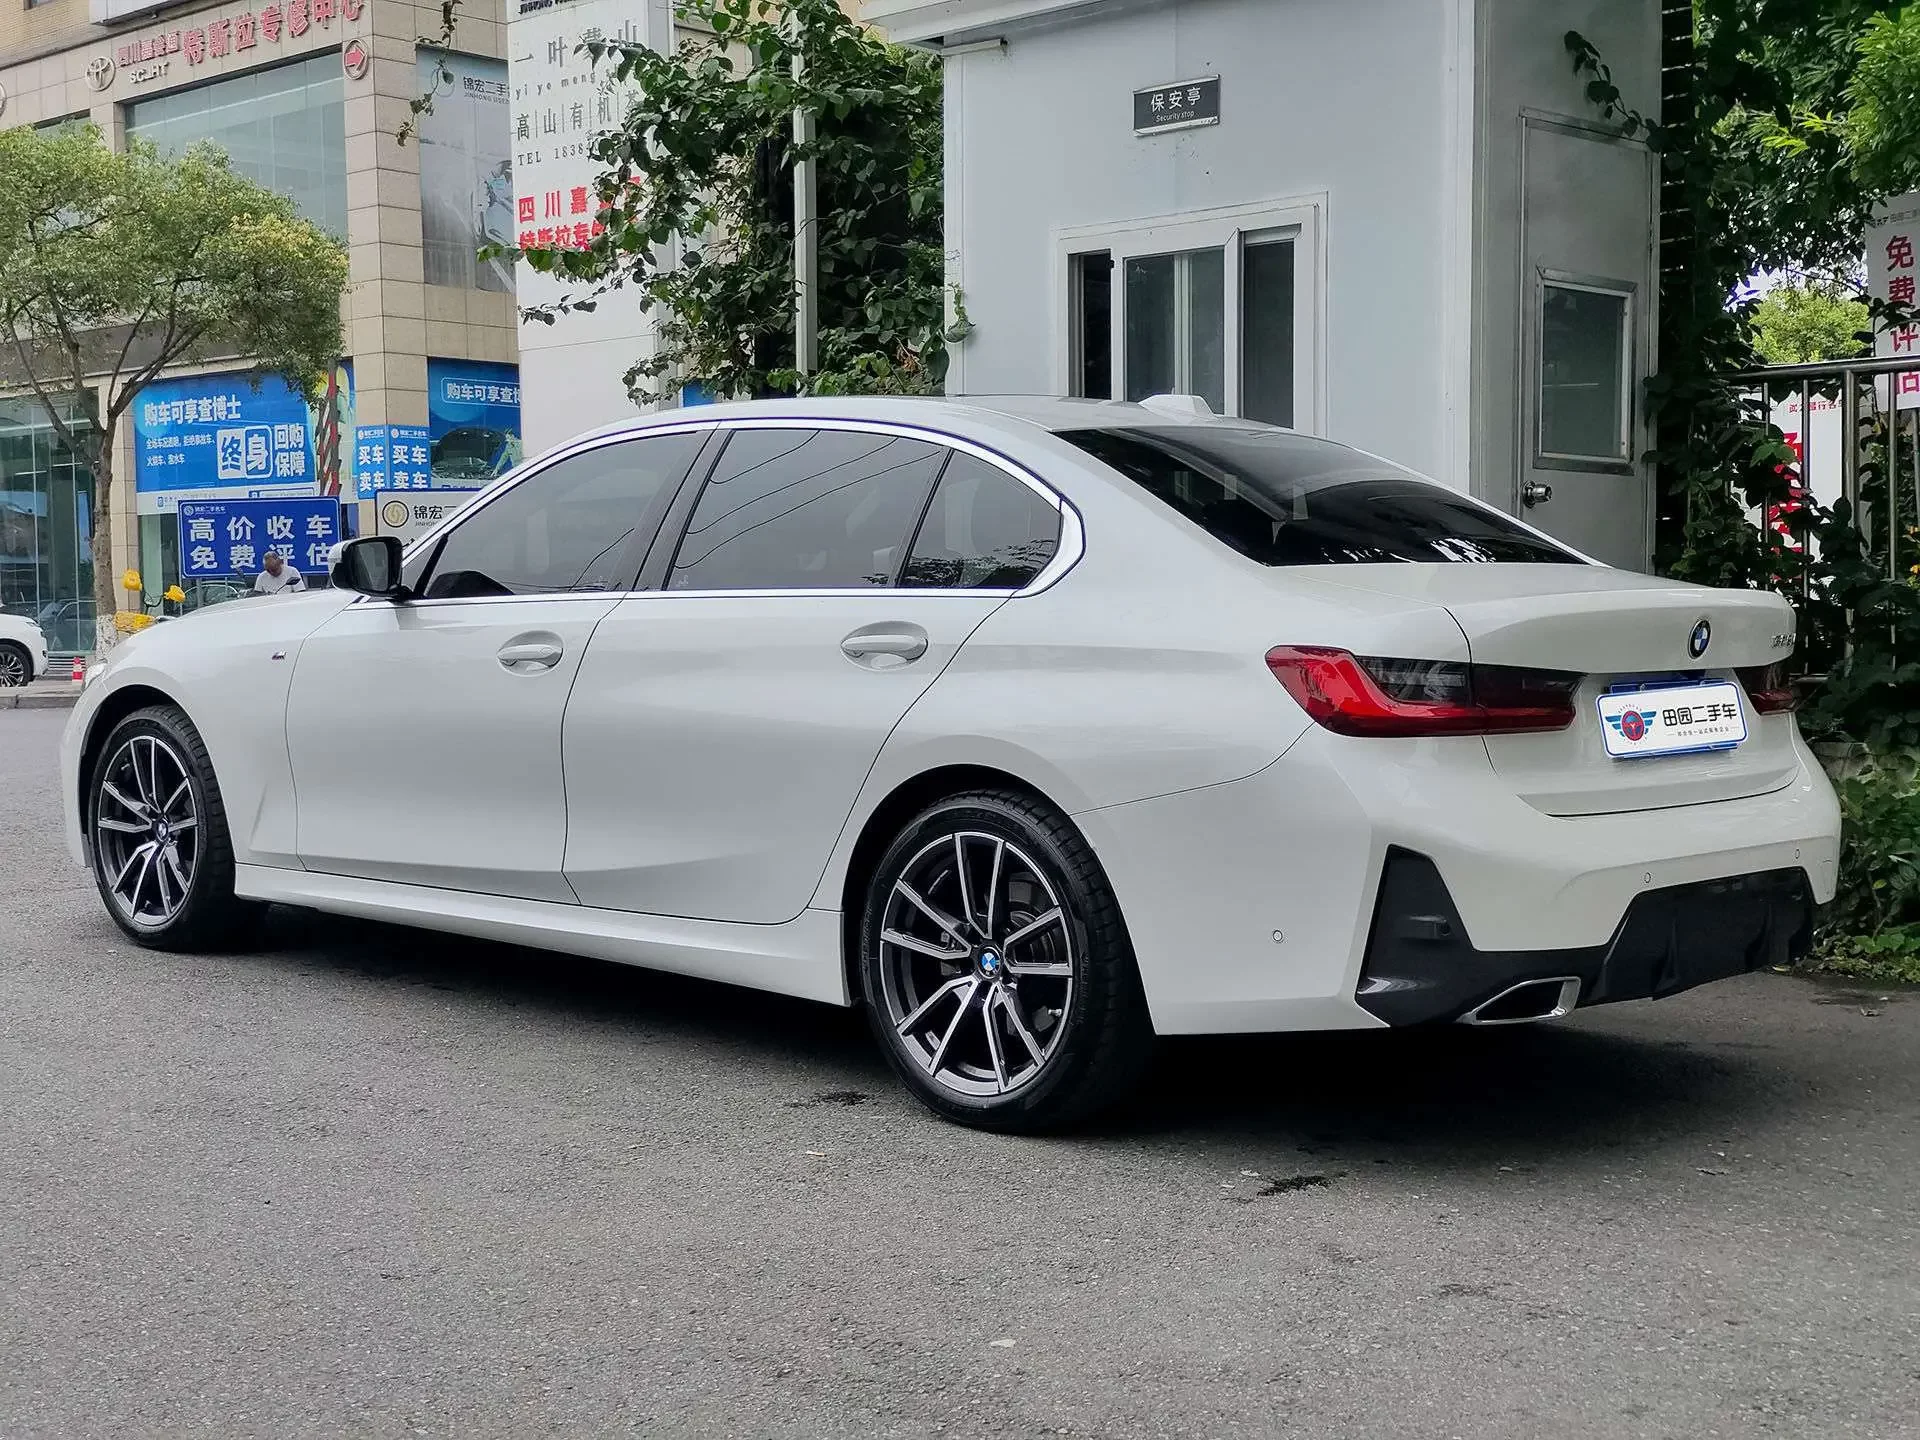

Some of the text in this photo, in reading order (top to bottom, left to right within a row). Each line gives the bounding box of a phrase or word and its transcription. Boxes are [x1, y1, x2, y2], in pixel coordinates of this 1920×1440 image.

[183, 0, 363, 66] 特斯拉专修中心
[463, 76, 509, 97] 锦宏二手
[1150, 86, 1202, 113] 保安亭
[1155, 112, 1180, 122] Security
[518, 142, 590, 166] TEL 1838
[144, 394, 241, 427] 购车可享查博士
[274, 424, 304, 450] 回购
[220, 433, 269, 472] 终身
[275, 451, 306, 478] 保障
[359, 445, 384, 465] 买车
[393, 445, 428, 465] 买车
[360, 471, 385, 491] 卖车
[393, 471, 428, 489] 卖车
[188, 515, 333, 542] 高价收车
[1662, 703, 1738, 727] 田园二手车
